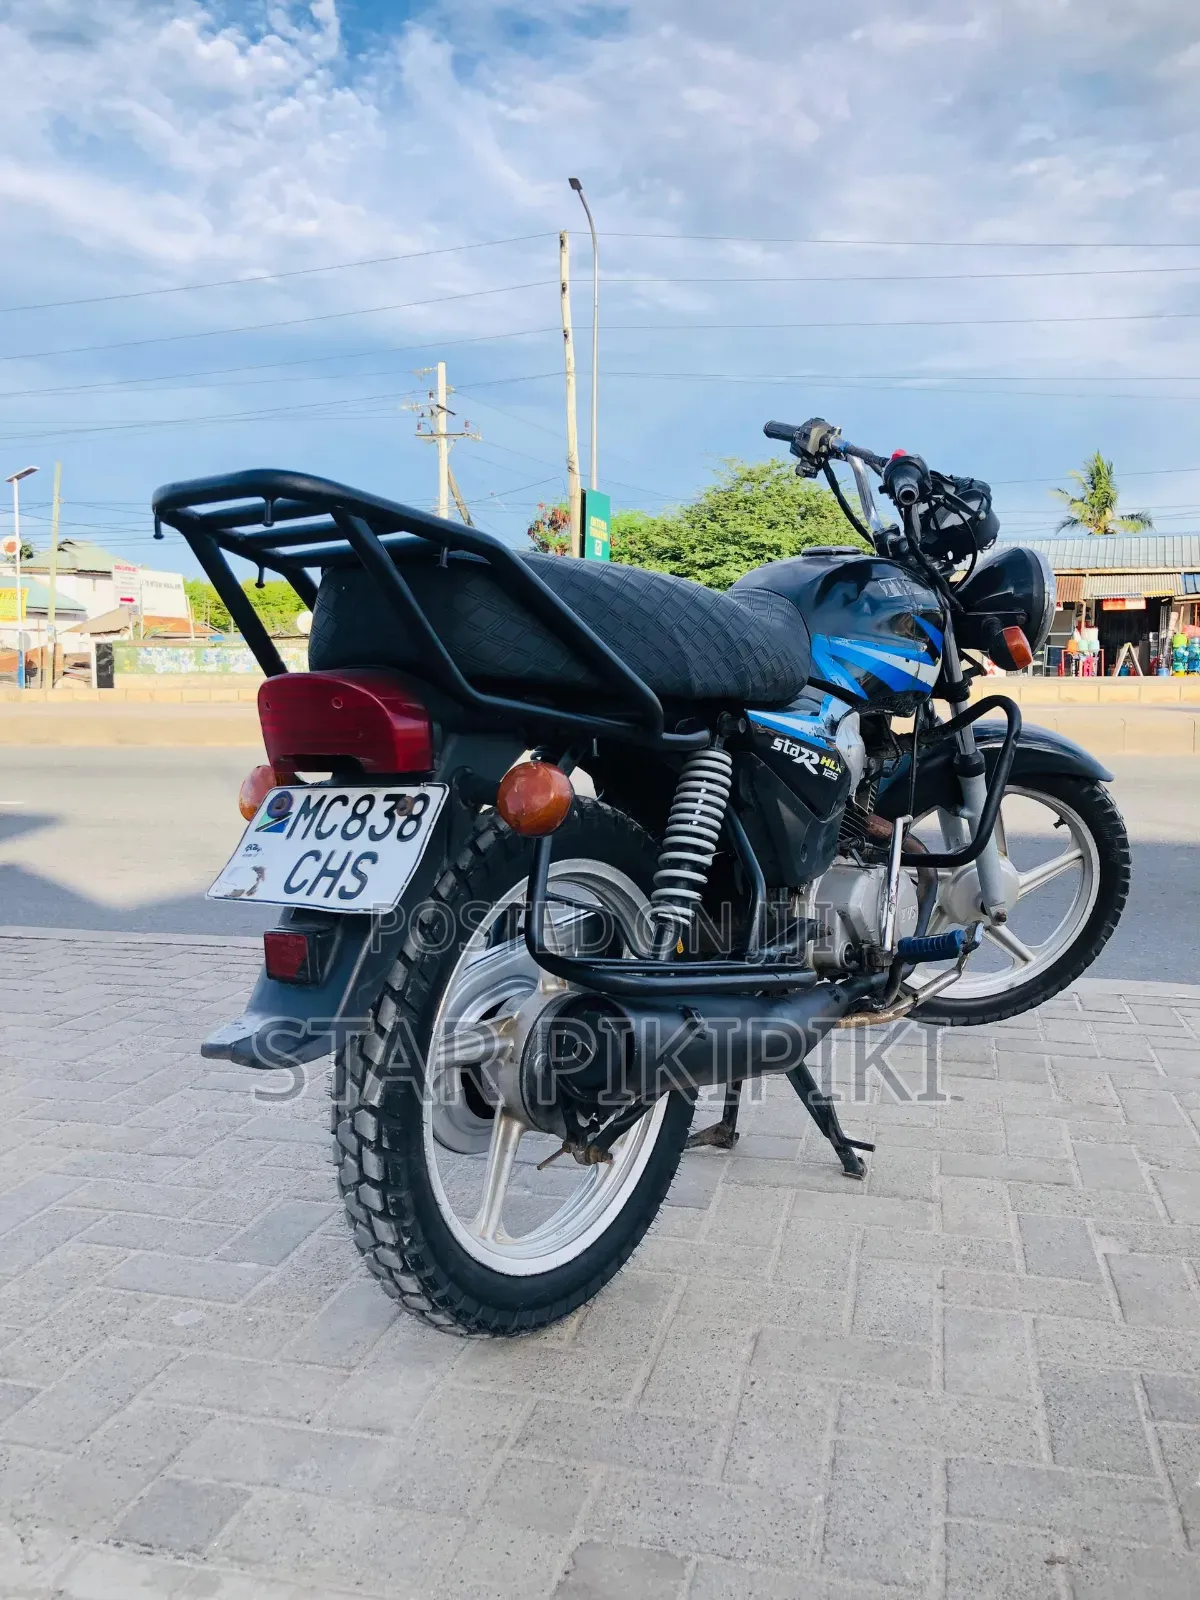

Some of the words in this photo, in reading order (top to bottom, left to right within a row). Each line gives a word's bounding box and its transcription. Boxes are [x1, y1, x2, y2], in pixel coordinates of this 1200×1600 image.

[820, 756, 842, 774] HLX
[822, 767, 839, 781] 125
[286, 793, 430, 842] MC838
[283, 849, 379, 900] CHS
